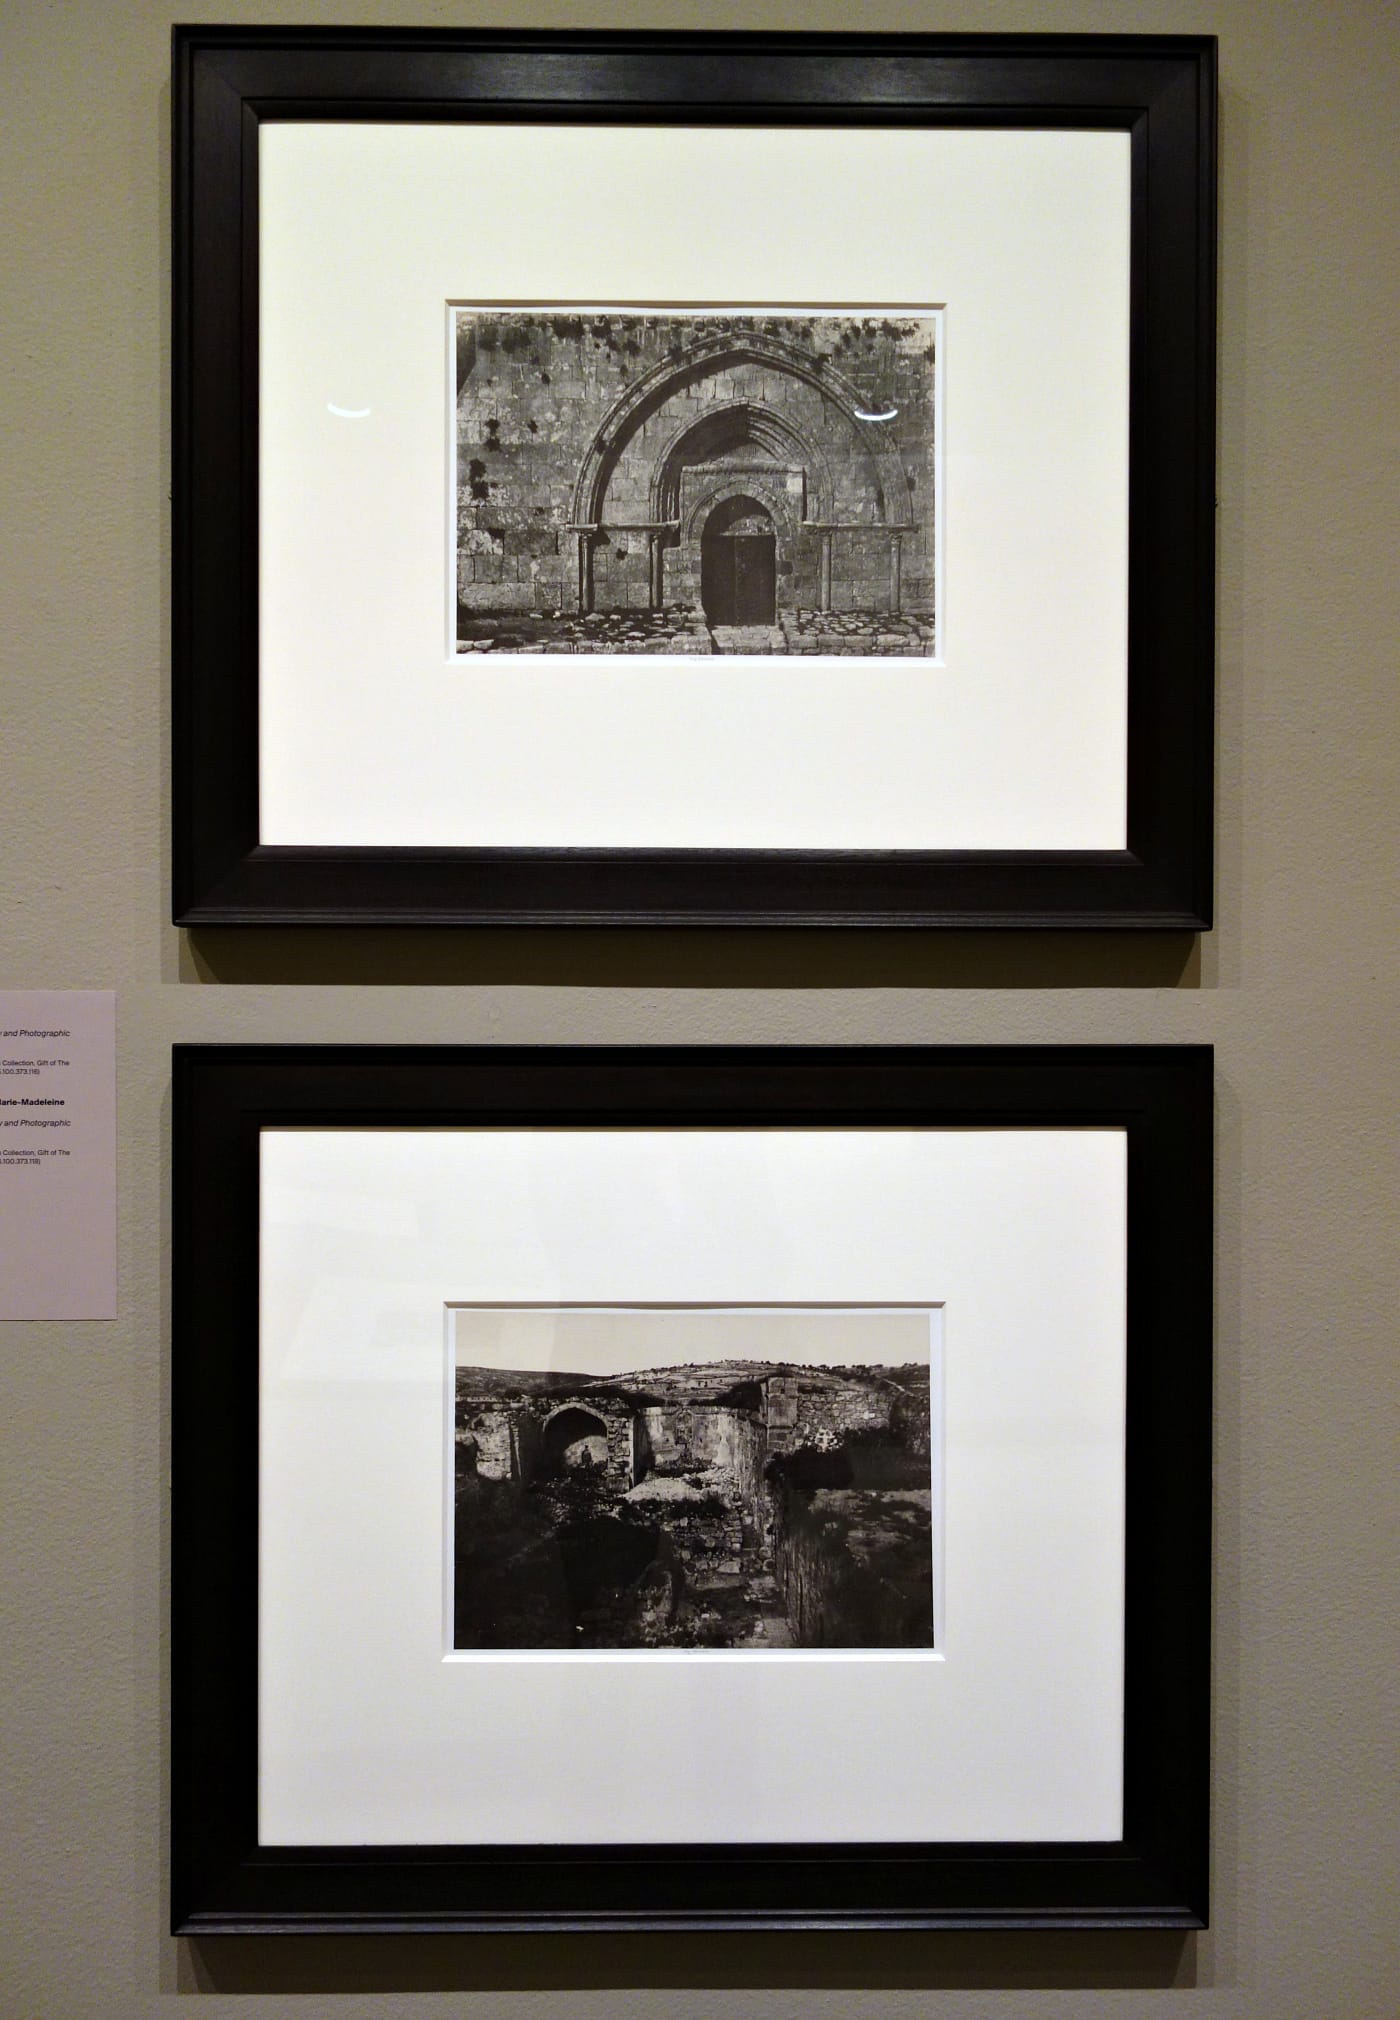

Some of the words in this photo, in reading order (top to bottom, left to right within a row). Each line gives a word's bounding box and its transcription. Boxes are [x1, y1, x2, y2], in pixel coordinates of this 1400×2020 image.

[19, 1029, 71, 1039] Photographic
[0, 1098, 65, 1106] arie-Madeleine
[20, 1119, 72, 1128] Photographic
